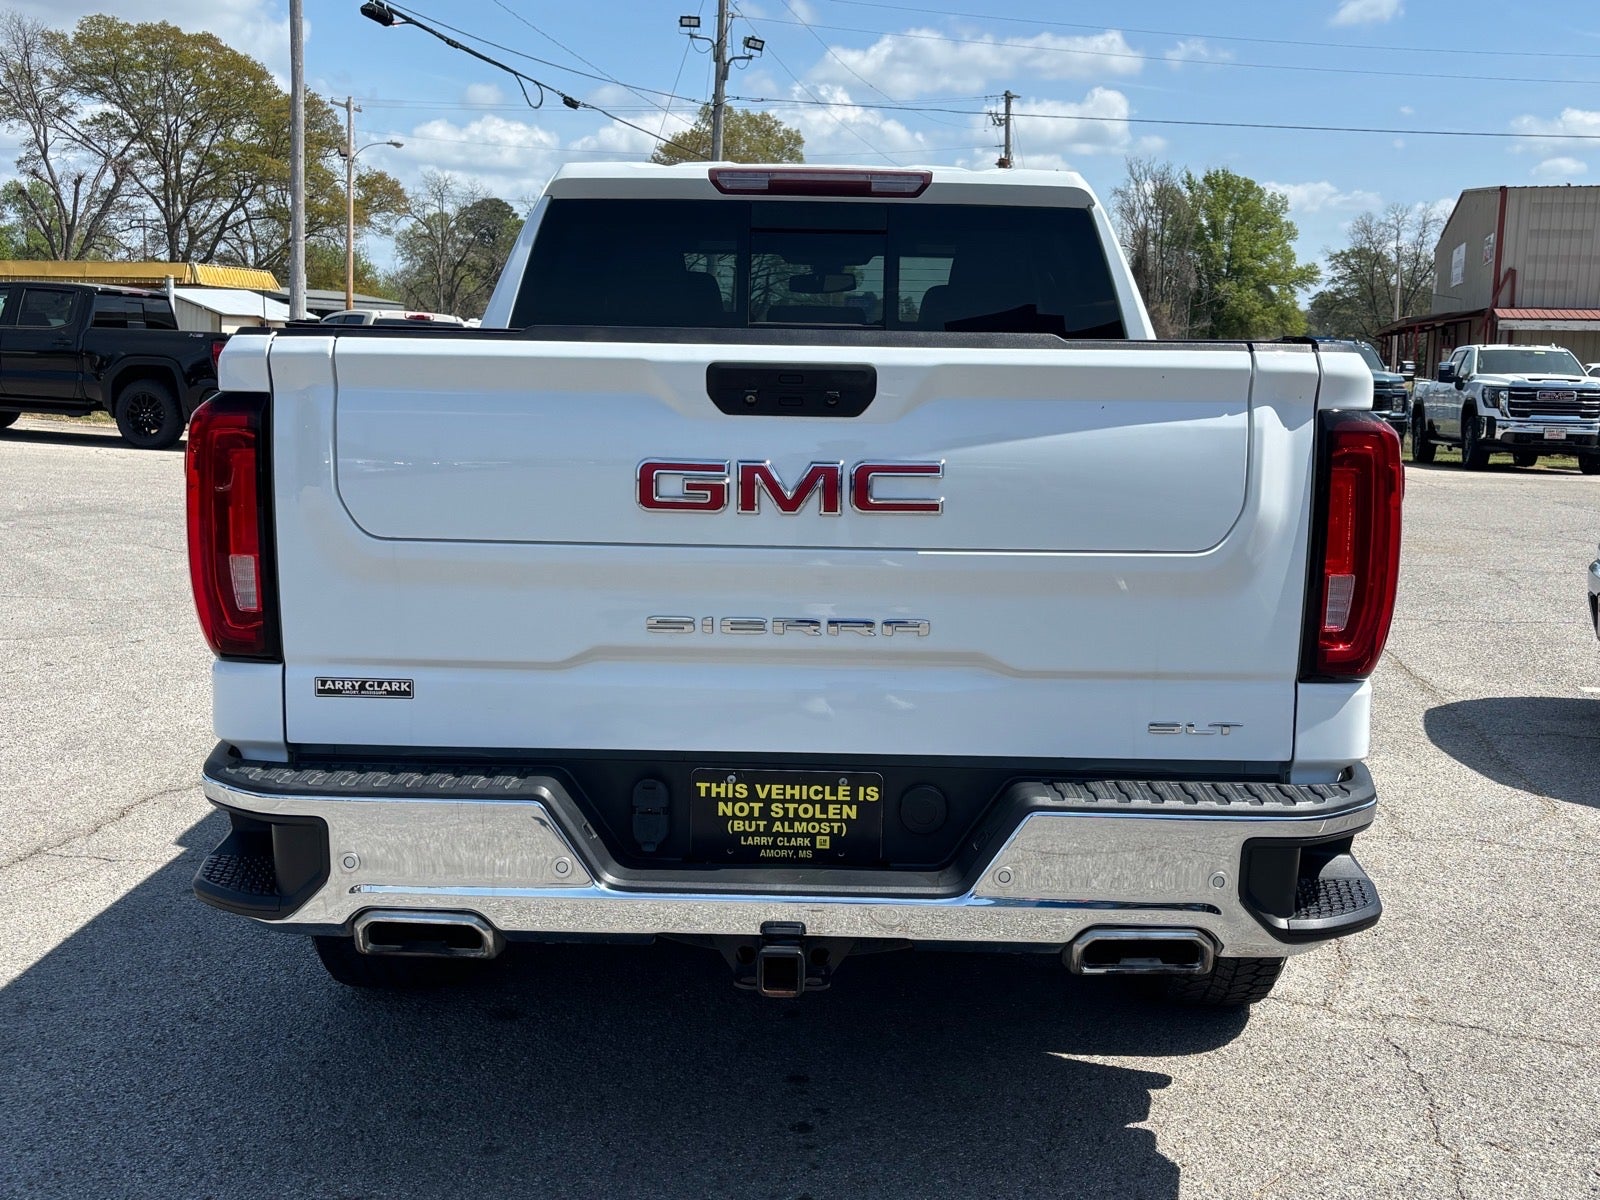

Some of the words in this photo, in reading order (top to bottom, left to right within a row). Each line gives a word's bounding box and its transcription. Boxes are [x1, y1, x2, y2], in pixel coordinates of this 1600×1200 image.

[635, 457, 946, 516] GMC
[646, 615, 931, 637] SIERRA
[317, 680, 361, 690] LARRY
[365, 681, 411, 692] CLARK
[1148, 721, 1244, 736] SLT
[696, 782, 748, 798] THIS
[755, 784, 851, 801] VEHICLE
[858, 786, 880, 802] IS
[717, 802, 764, 818] NOT
[770, 803, 857, 819] STOLEN
[727, 820, 767, 834] (BUT
[772, 821, 847, 837] ALMOST)
[740, 836, 774, 846] LARRY
[777, 837, 811, 847] CLARK
[760, 849, 797, 859] AMORY,
[798, 850, 813, 858] MS
